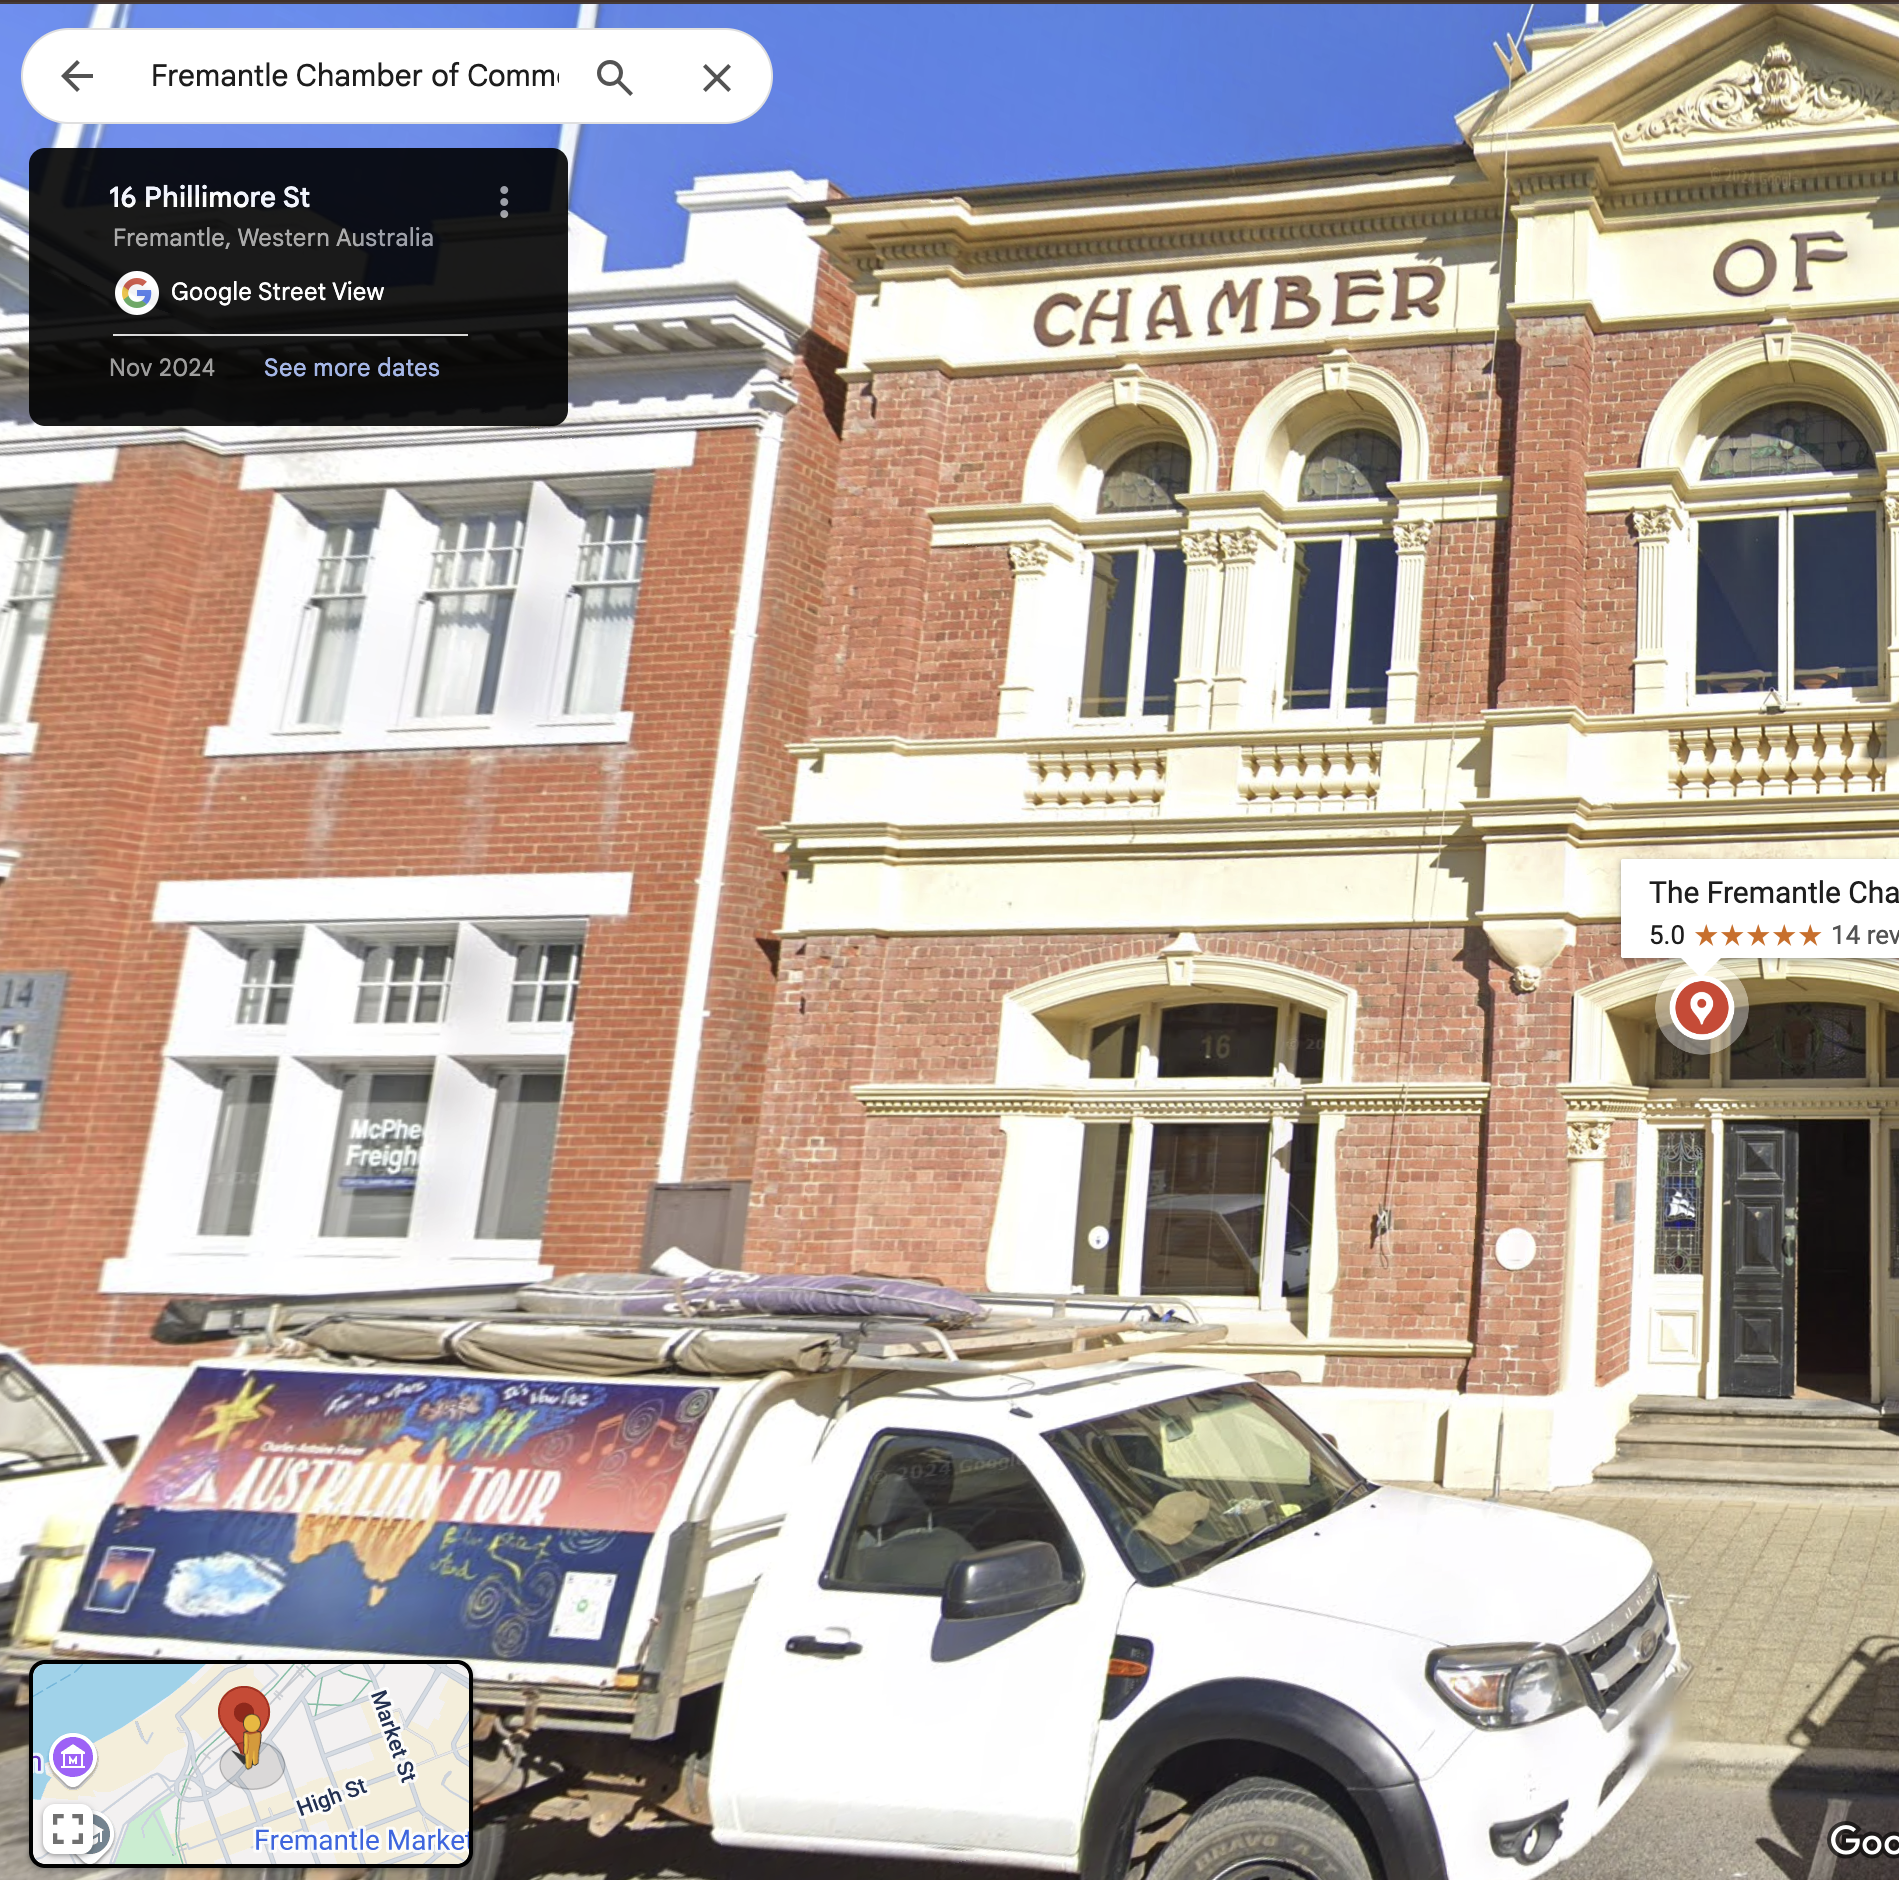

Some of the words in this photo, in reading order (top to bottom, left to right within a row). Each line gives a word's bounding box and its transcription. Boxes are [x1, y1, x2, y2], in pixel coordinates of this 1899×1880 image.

[1034, 265, 1447, 347] CHAMBER
[1714, 231, 1848, 296] OF
[1202, 1034, 1231, 1059] 16
[351, 1119, 423, 1139] McPhe
[345, 1144, 419, 1174] Freigh
[222, 1456, 456, 1521] AUSTRALIAN
[452, 1465, 562, 1527] TOUR
[1195, 1833, 1279, 1871] BRAVO
